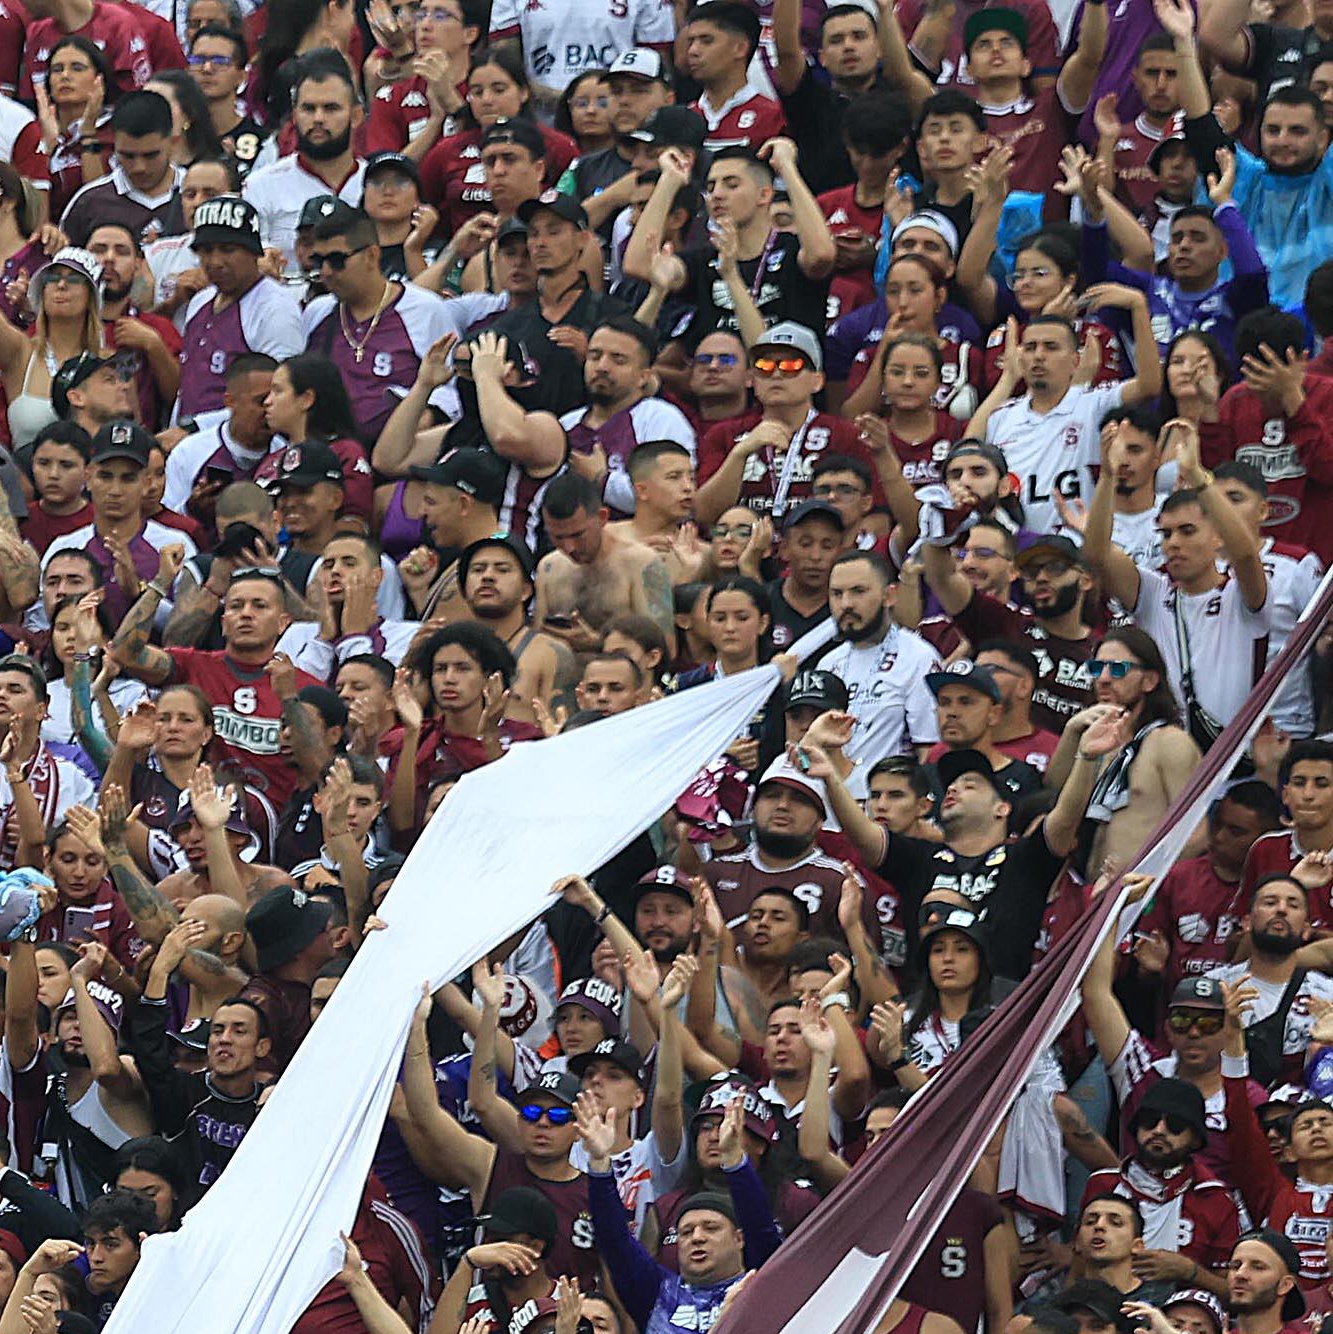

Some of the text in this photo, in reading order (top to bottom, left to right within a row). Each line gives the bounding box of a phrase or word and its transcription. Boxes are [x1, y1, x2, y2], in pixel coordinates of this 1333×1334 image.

[567, 43, 613, 67] BAC
[236, 134, 258, 158] S
[374, 356, 391, 375] S
[808, 427, 828, 449] S
[1263, 420, 1283, 444] S
[1059, 658, 1091, 683] BA
[234, 689, 256, 714] S
[657, 866, 675, 884] S
[585, 979, 623, 1016] GUI-2
[1196, 979, 1213, 996] S
[572, 1218, 594, 1248] S
[941, 1245, 966, 1278] S
